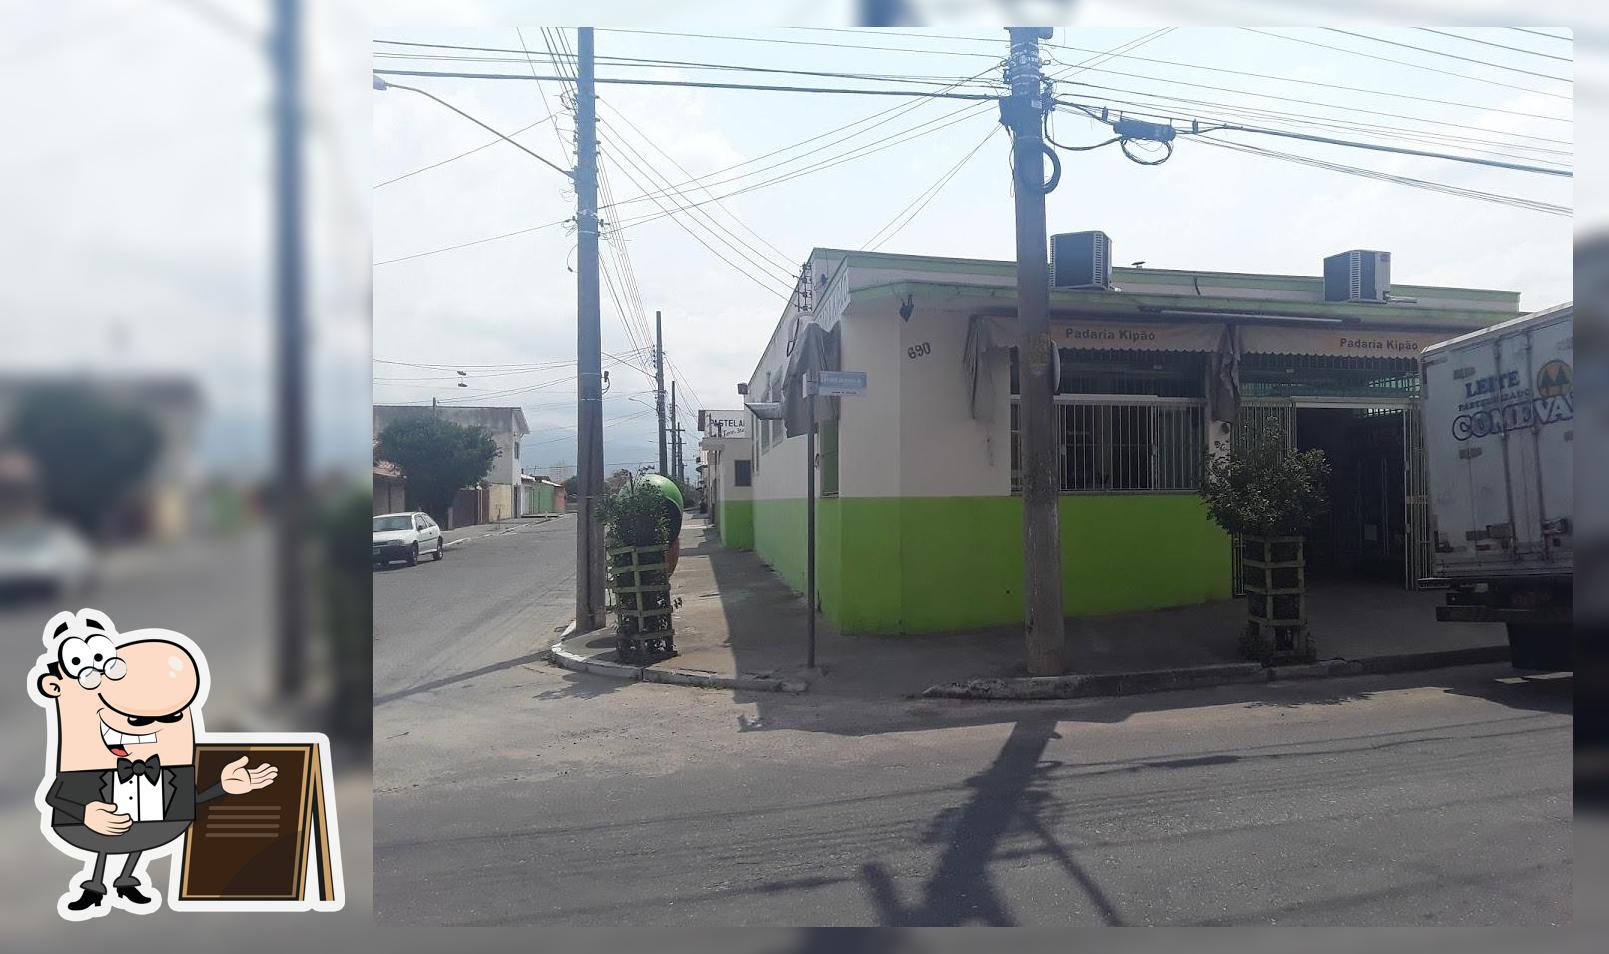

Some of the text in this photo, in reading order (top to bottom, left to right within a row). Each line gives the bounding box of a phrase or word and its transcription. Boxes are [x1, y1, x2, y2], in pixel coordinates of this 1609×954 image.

[1065, 327, 1156, 343] Padaria Kipão
[907, 342, 931, 359] 690
[1340, 337, 1418, 352] Padaria Kipão
[1465, 370, 1521, 398] LEITE
[1452, 391, 1573, 441] COMEVA
